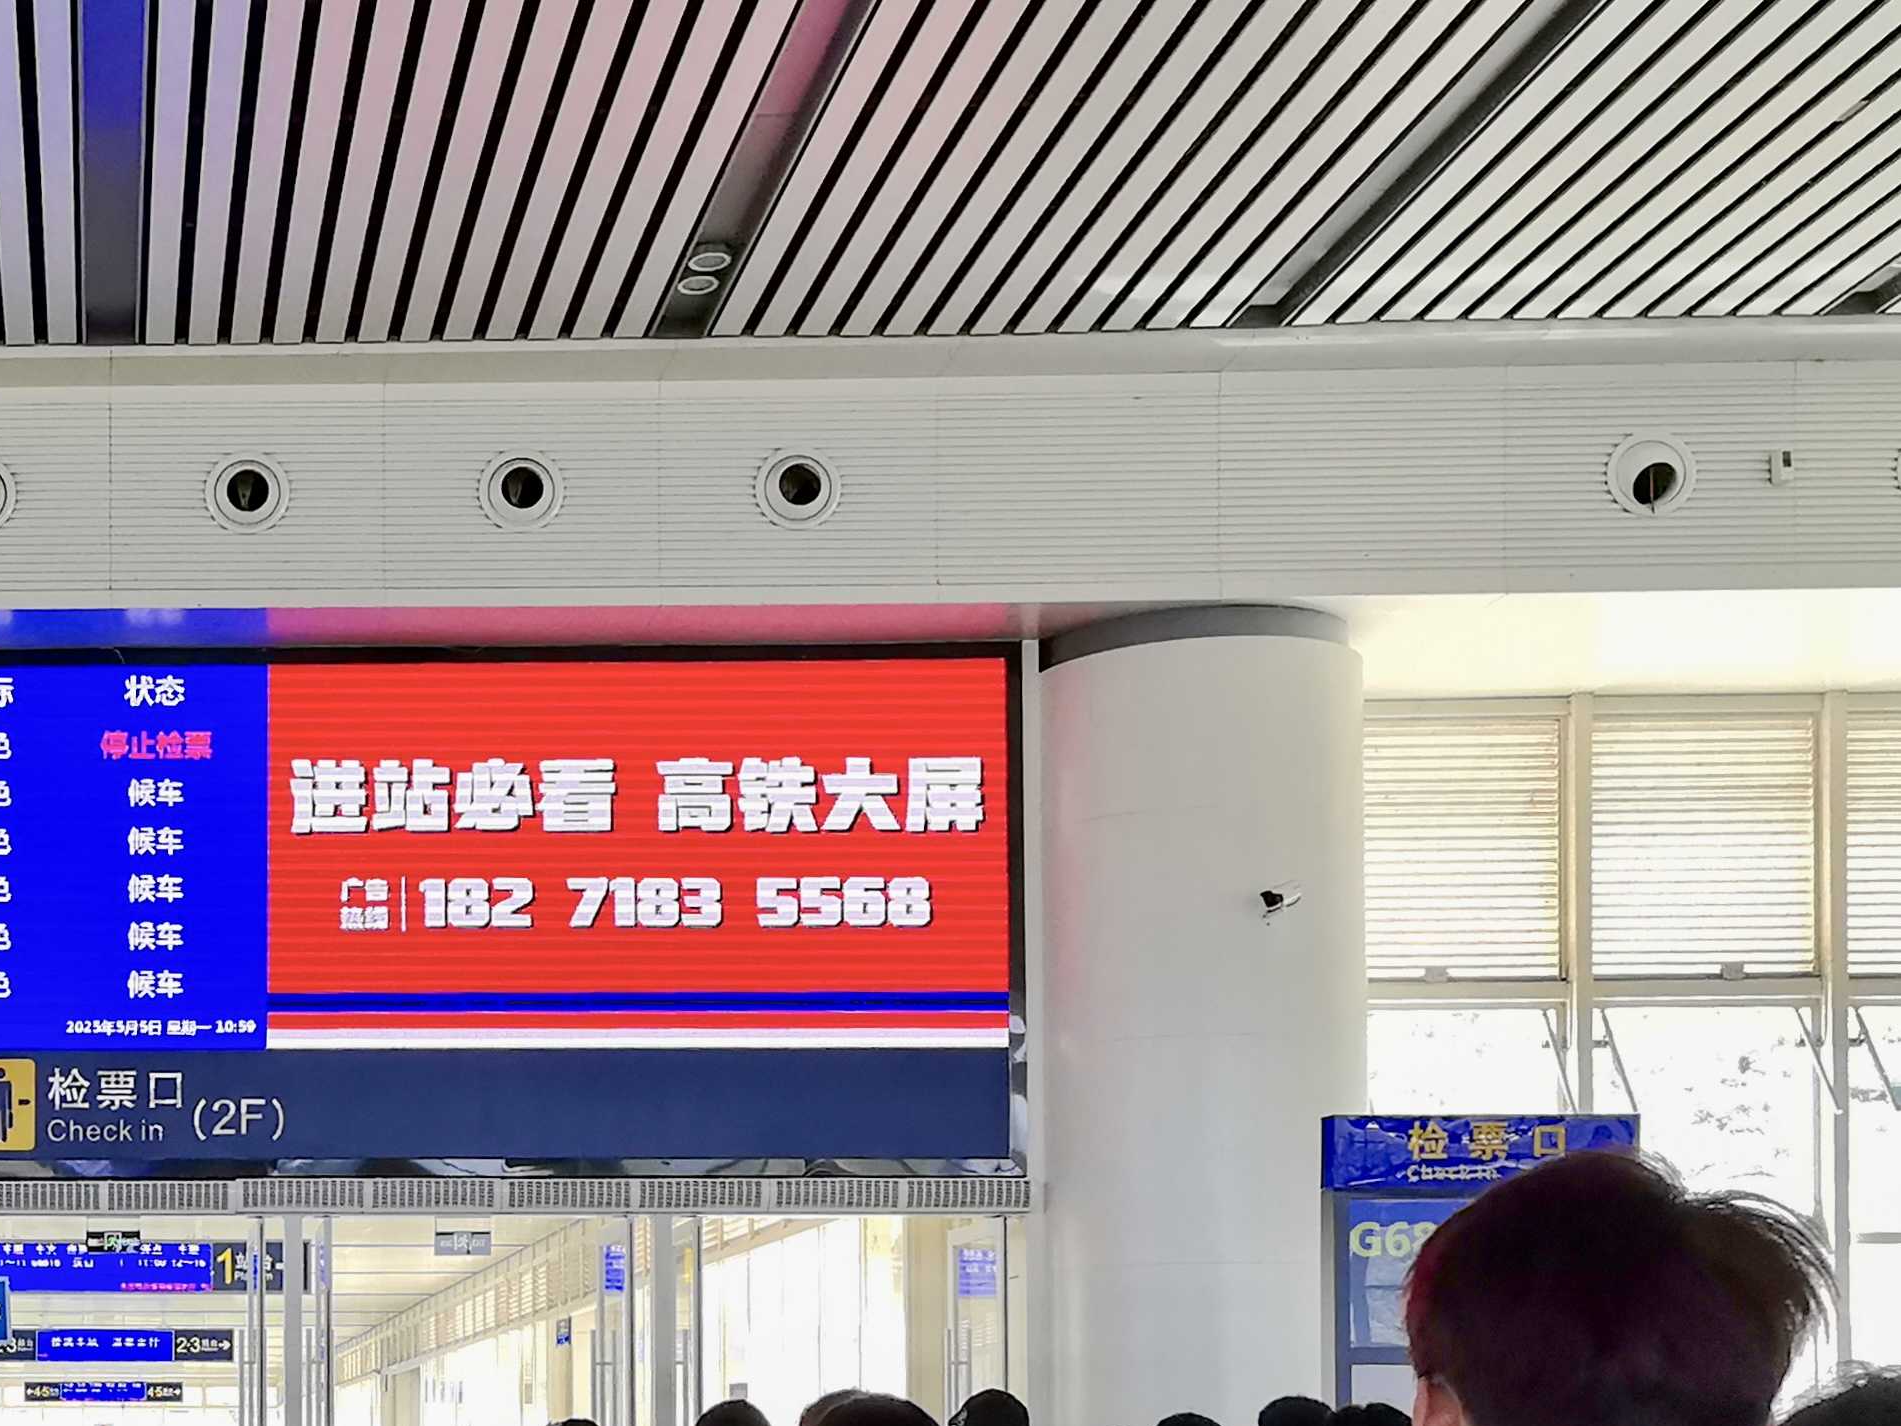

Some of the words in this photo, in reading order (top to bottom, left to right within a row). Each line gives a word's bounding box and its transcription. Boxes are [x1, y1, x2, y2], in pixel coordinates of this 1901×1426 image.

[123, 674, 186, 707] 状态
[100, 730, 213, 760] 停止检票
[127, 778, 185, 808] 候车
[289, 757, 616, 834] 进站必看
[655, 756, 985, 833] 高铁大屏
[127, 826, 184, 856] 候车
[127, 873, 184, 904] 候车
[418, 877, 534, 928] 182
[566, 876, 723, 928] 7183
[756, 876, 932, 927] 5568
[127, 921, 184, 951] 候车
[126, 969, 184, 999] 候车
[47, 1067, 183, 1111] 检票口
[47, 1119, 132, 1142] Check
[141, 1120, 163, 1141] in
[193, 1098, 285, 1141] (2F)
[1407, 1120, 1567, 1161] 检票口
